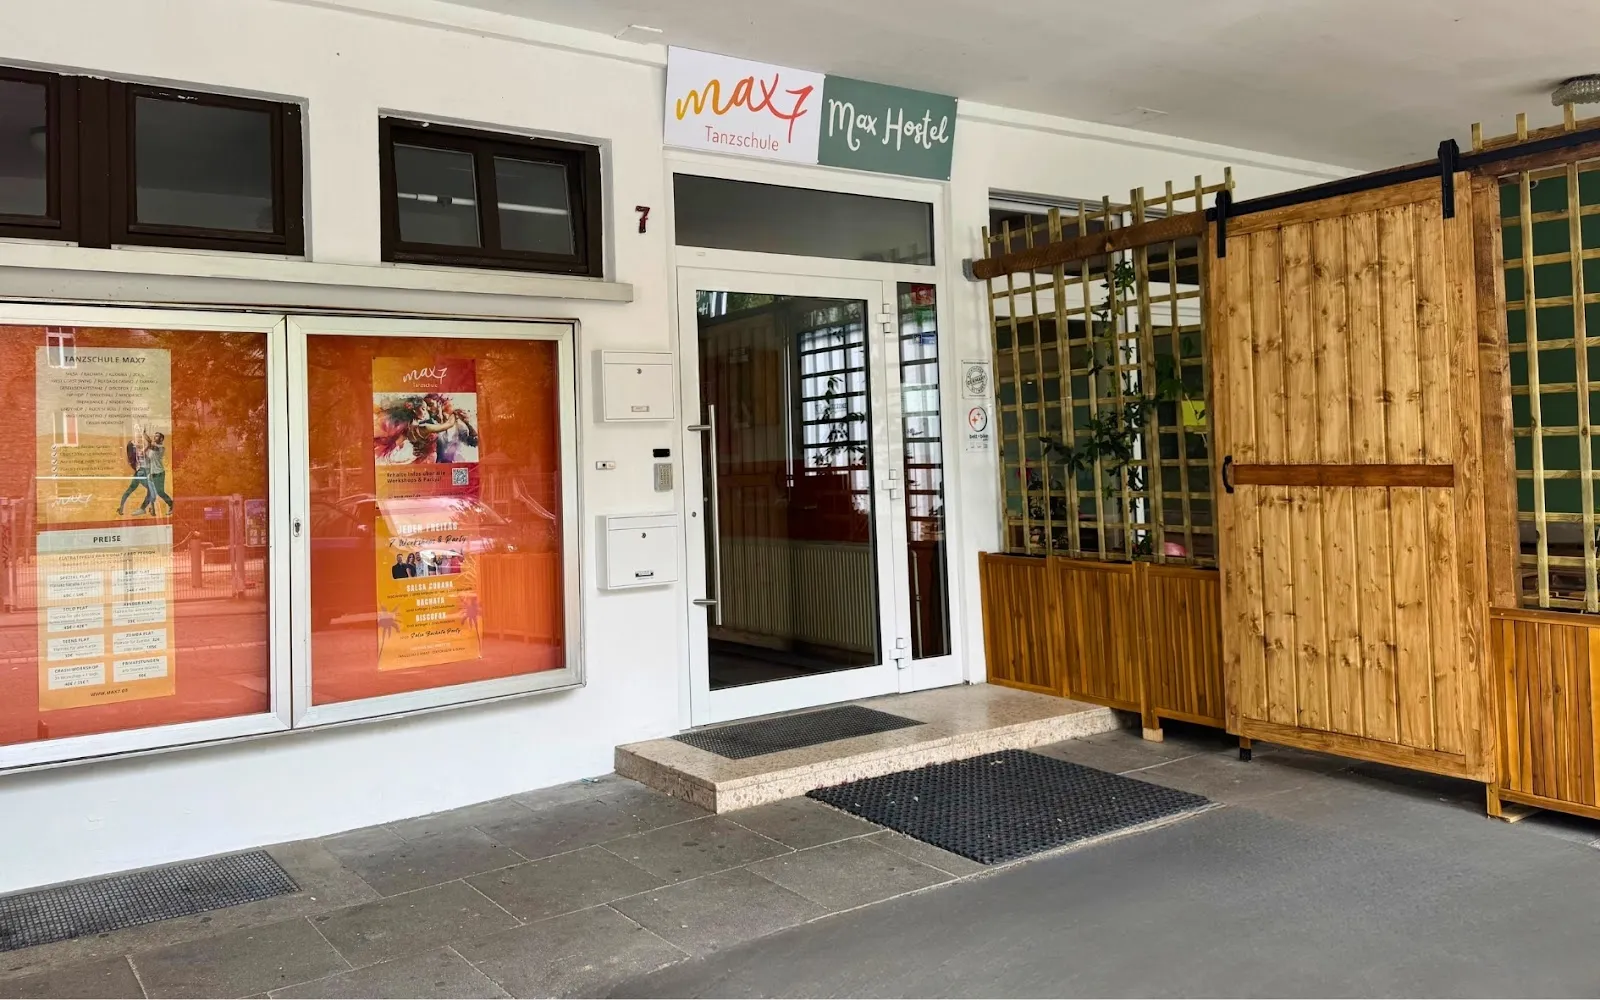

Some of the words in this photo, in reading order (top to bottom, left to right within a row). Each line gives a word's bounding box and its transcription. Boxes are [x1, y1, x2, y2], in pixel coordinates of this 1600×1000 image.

[675, 73, 814, 143] max7
[828, 98, 877, 152] Max
[881, 107, 949, 151] Hostel
[704, 125, 780, 152] Tanzschule
[634, 205, 651, 234] 7
[64, 355, 120, 364] TANZSCHULE
[122, 356, 146, 364] MAX7
[402, 365, 448, 385] max7
[93, 535, 121, 544] PREISE
[445, 534, 467, 544] Party
[406, 583, 427, 592] SALSA
[416, 596, 445, 607] BACHATA
